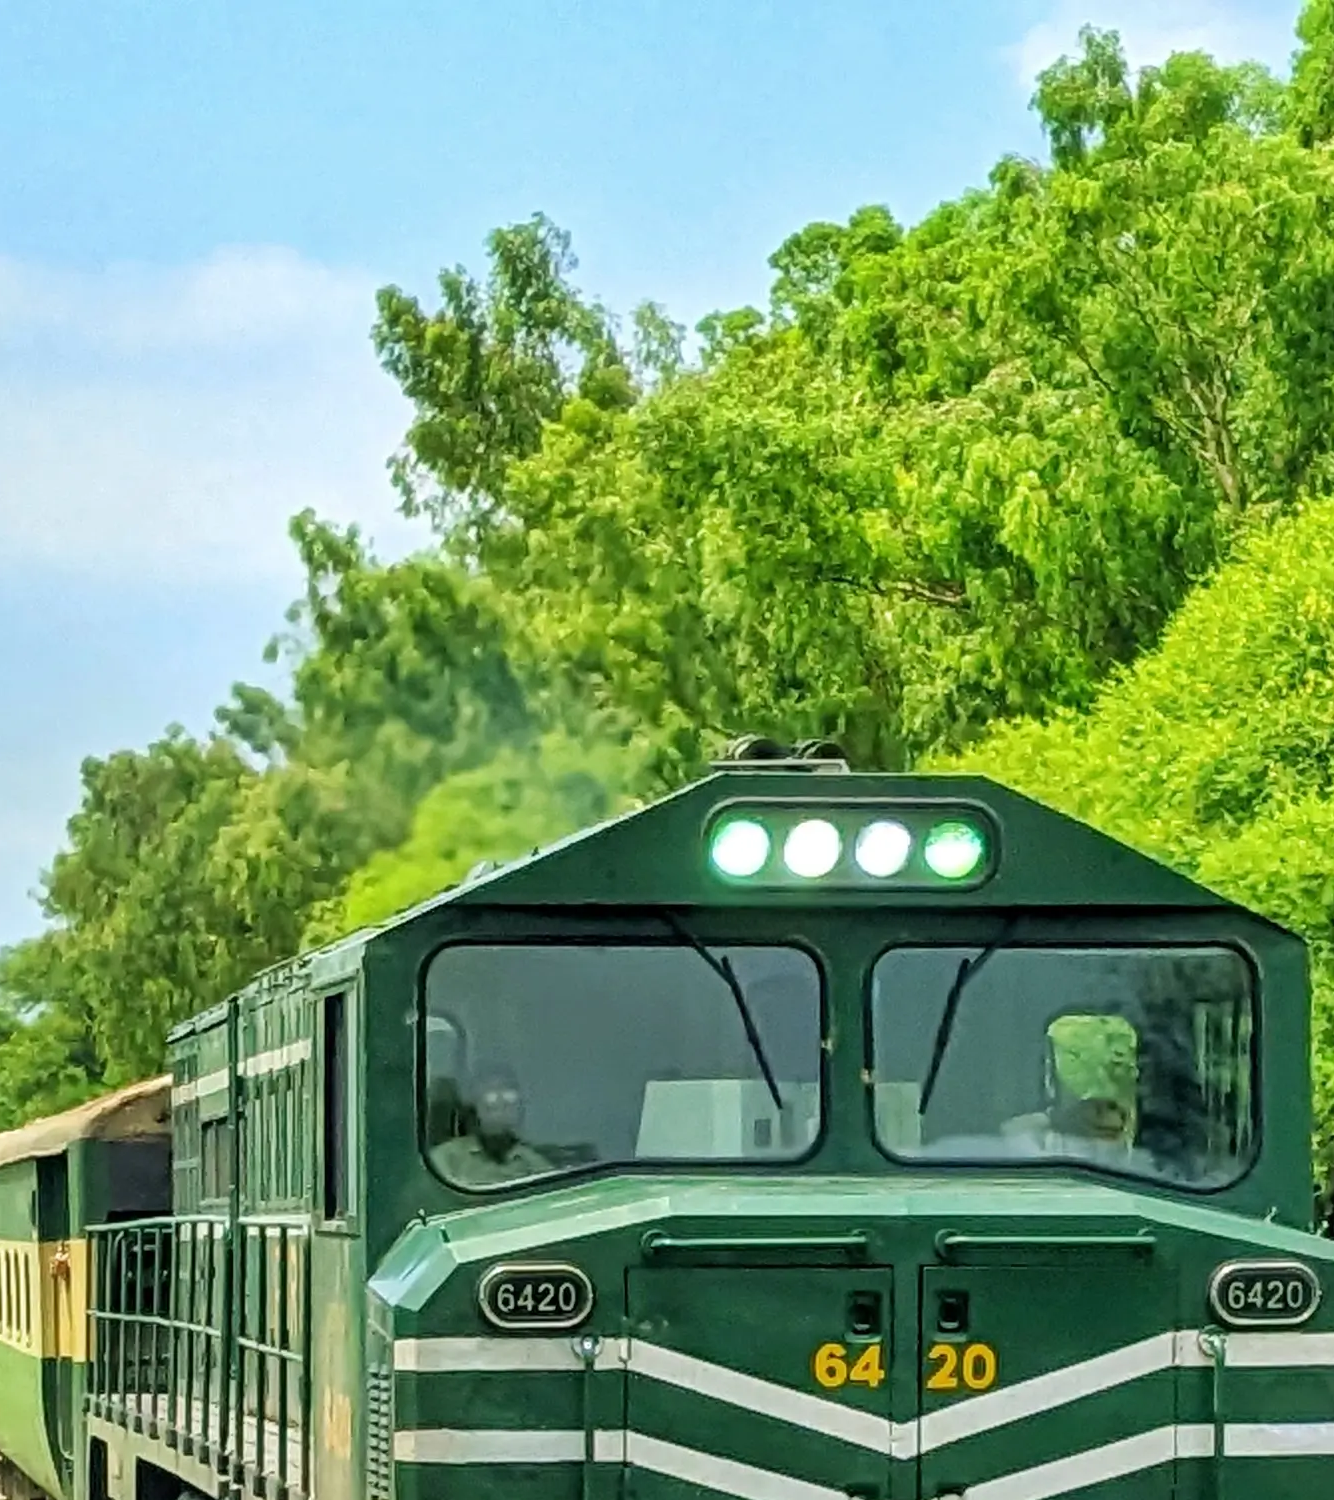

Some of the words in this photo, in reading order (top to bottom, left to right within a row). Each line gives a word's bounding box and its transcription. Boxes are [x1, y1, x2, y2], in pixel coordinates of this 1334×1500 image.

[497, 1282, 577, 1312] 6420
[1226, 1280, 1303, 1310] 6420
[813, 1343, 885, 1388] 64
[925, 1344, 997, 1390] 20
